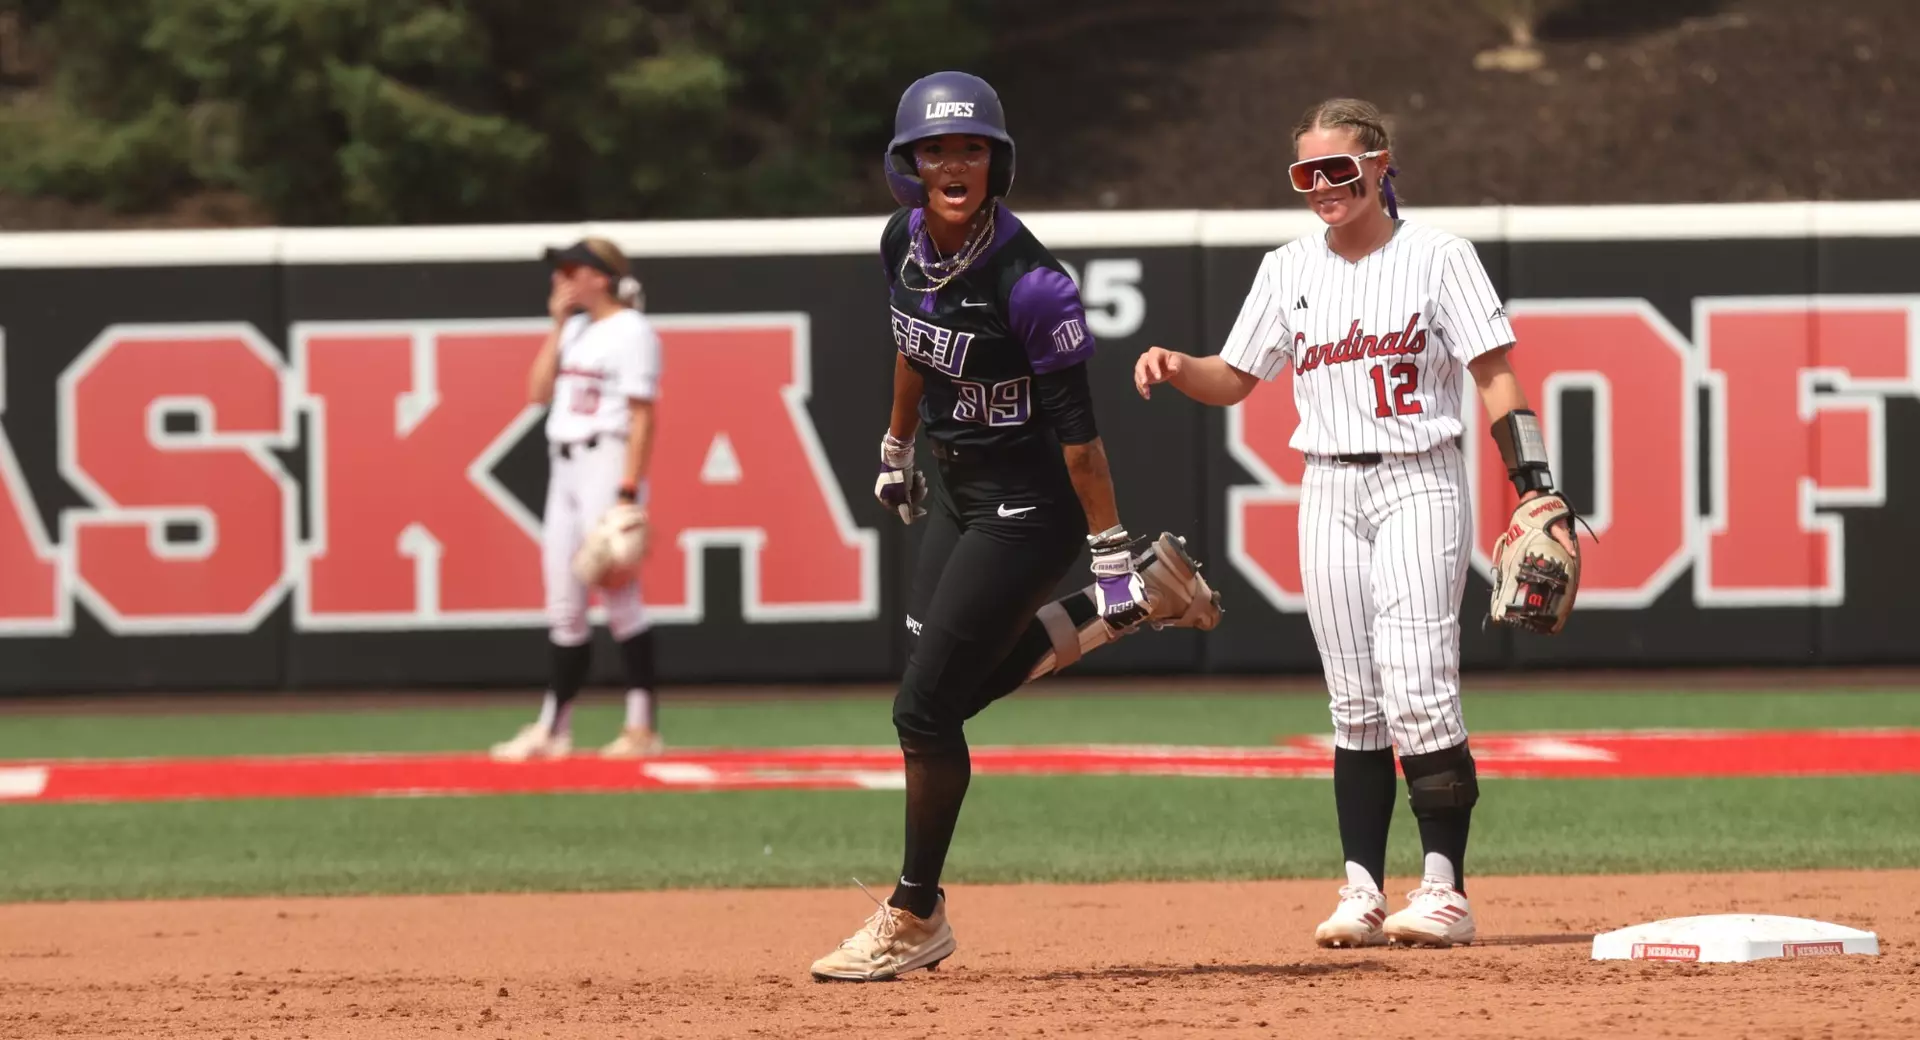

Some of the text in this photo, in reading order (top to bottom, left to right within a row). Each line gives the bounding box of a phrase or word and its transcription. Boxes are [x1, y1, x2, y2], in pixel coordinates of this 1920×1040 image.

[925, 101, 975, 120] LOPES
[1056, 257, 1146, 338] 5
[889, 304, 976, 378] GCU
[1294, 312, 1427, 376] Cardinals
[1369, 362, 1423, 418] 12
[1226, 295, 1920, 612] OF
[1647, 946, 1696, 959] NEBRASKA
[1797, 945, 1841, 957] NEBRASKA
